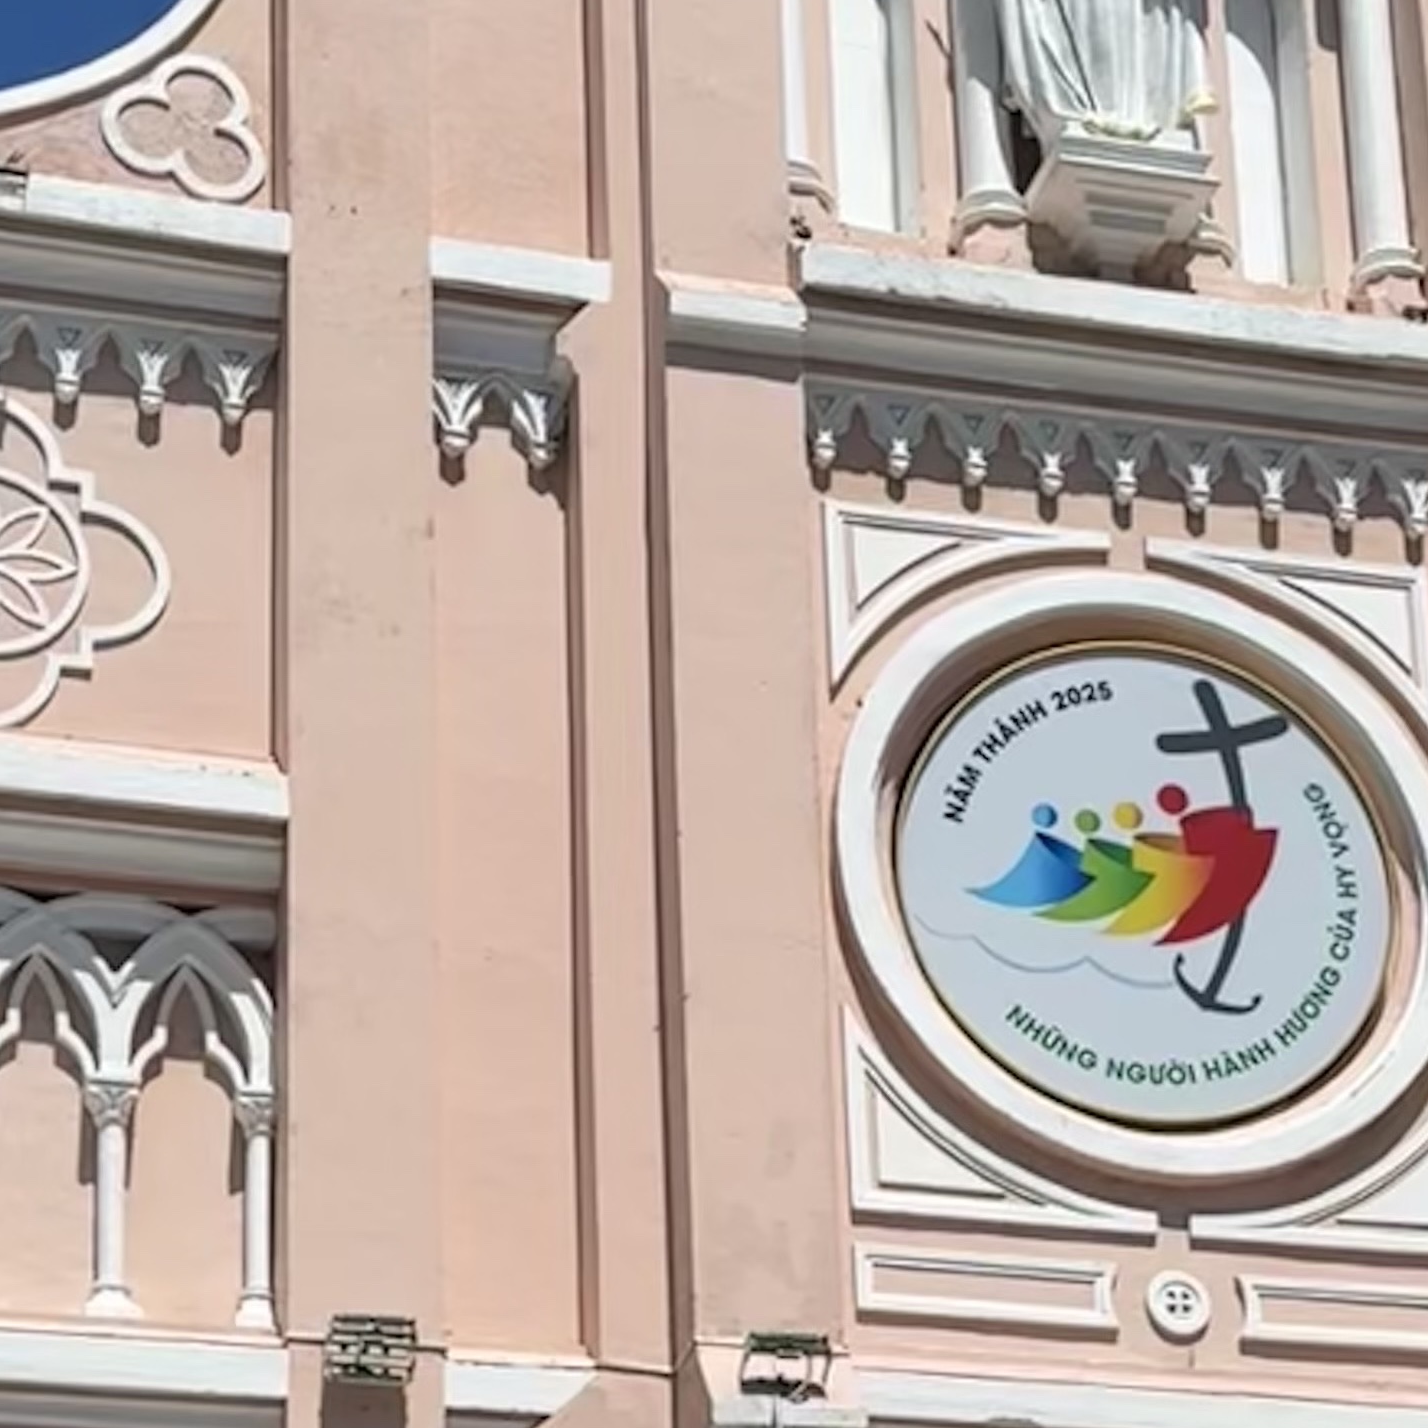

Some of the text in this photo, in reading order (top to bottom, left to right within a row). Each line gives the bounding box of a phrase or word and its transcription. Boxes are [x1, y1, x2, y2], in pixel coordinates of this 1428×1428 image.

[943, 764, 983, 823] NĂM
[1050, 681, 1113, 712] 2025
[1303, 783, 1349, 858] VỌNG
[1335, 866, 1358, 898] HY
[1327, 908, 1357, 961] CỦA
[1202, 1038, 1275, 1082] HÀNH
